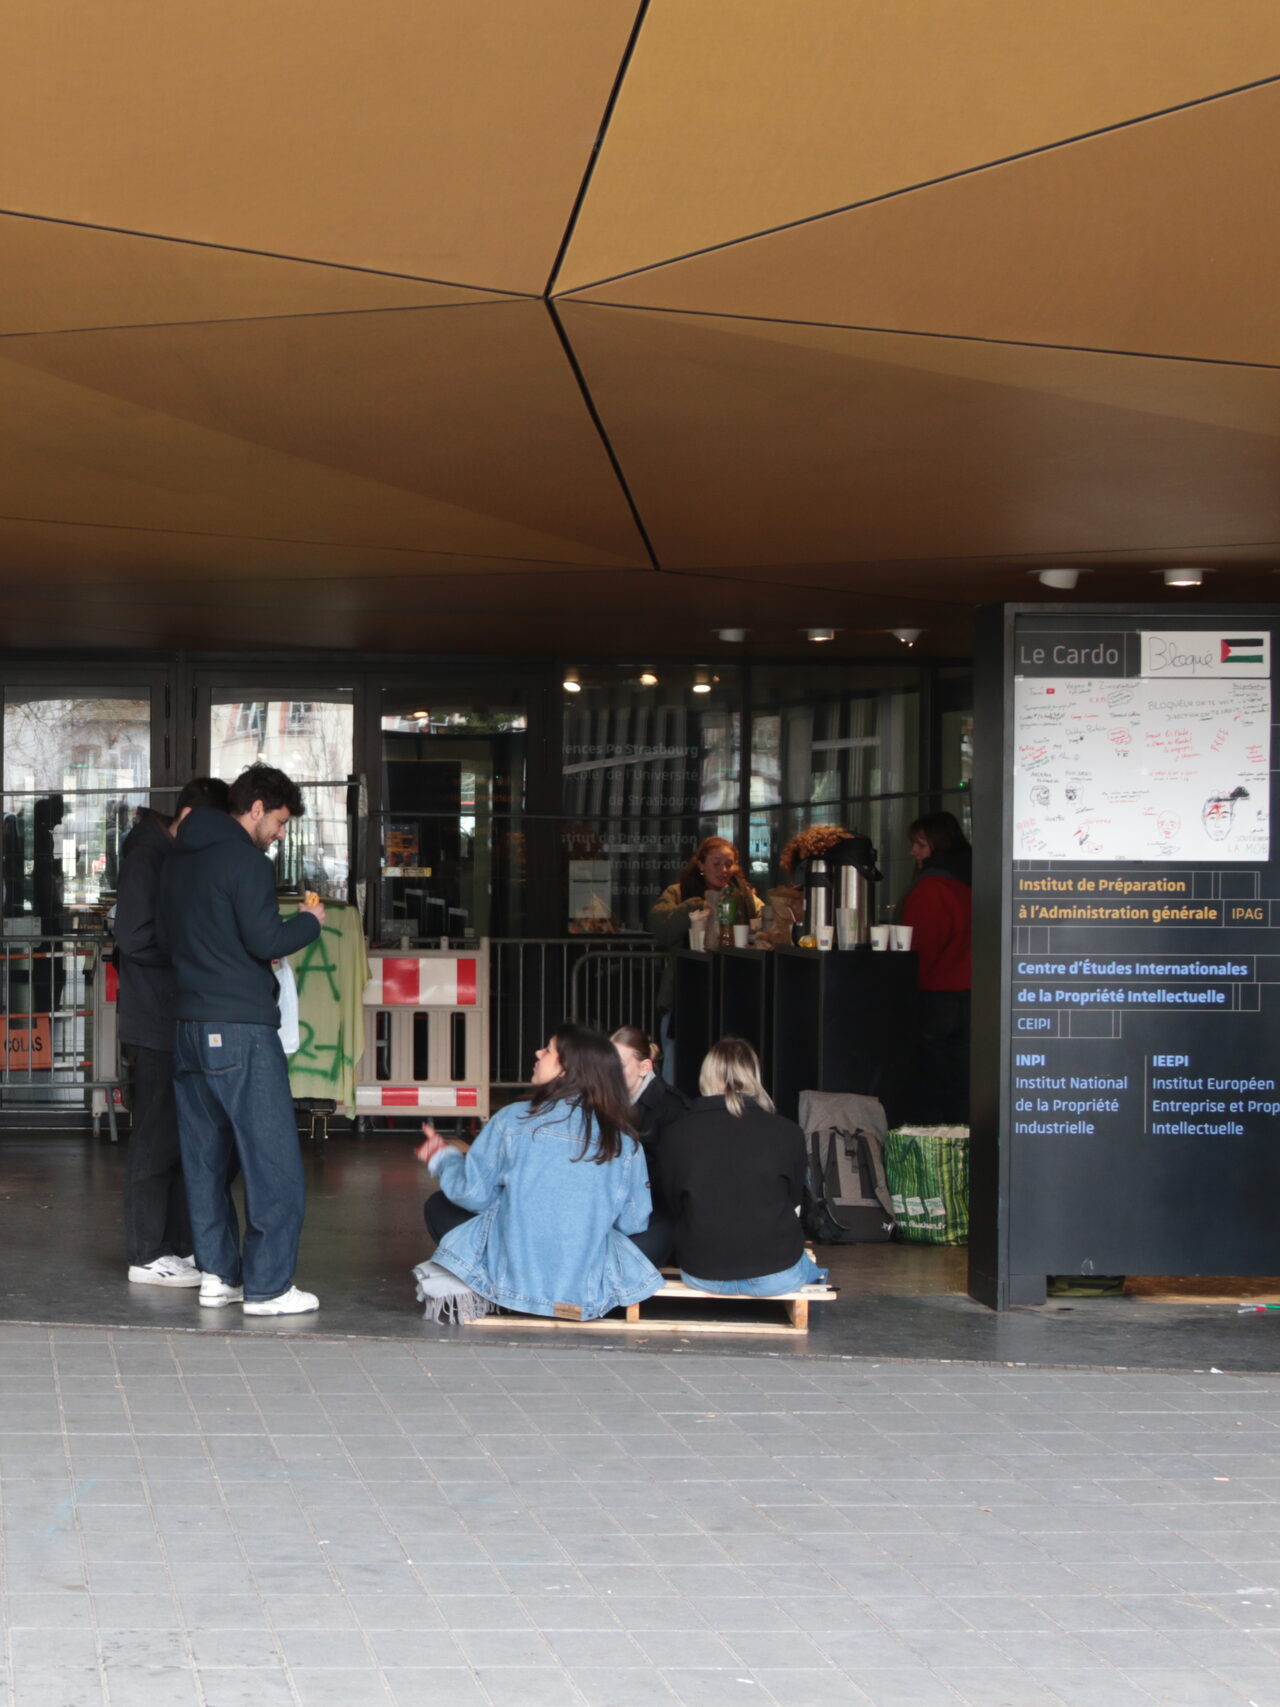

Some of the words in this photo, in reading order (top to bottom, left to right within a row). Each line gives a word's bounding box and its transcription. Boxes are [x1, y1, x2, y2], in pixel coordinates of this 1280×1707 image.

[1021, 645, 1045, 664] Le
[1053, 643, 1119, 664] Cardo
[1148, 636, 1214, 674] Bloqué
[625, 743, 699, 760] Strasbourg
[627, 793, 698, 810] Strasbourg
[611, 857, 689, 870] ministratio
[1019, 876, 1074, 892] Institut
[1076, 877, 1096, 892] de
[1098, 876, 1186, 895] Préparation
[1018, 904, 1028, 919] à
[1030, 904, 1150, 920] l'Administration
[1151, 905, 1218, 924] générale
[1231, 907, 1264, 920] IPAG
[1017, 961, 1067, 975] Centre
[1068, 958, 1133, 975] d'Études
[1134, 961, 1249, 976] Internationales
[1017, 988, 1037, 1003] de
[1038, 988, 1053, 1003] la
[1054, 988, 1126, 1006] Propriété
[1126, 988, 1226, 1004] Intellectuelle
[1017, 1017, 1051, 1031] CEIPI
[1015, 1054, 1046, 1067] INPI
[1152, 1054, 1189, 1068] IEEPI
[1015, 1075, 1067, 1089] Institut
[1070, 1075, 1128, 1090] National
[1152, 1076, 1204, 1090] Institut
[1207, 1076, 1275, 1094] Européen
[1015, 1097, 1034, 1112] de
[1036, 1097, 1050, 1112] la
[1052, 1098, 1120, 1116] Propriété
[1152, 1099, 1227, 1116] Entreprise
[1229, 1100, 1245, 1113] et
[1015, 1120, 1095, 1135] Industrielle
[1152, 1120, 1245, 1136] Intellectuelle
